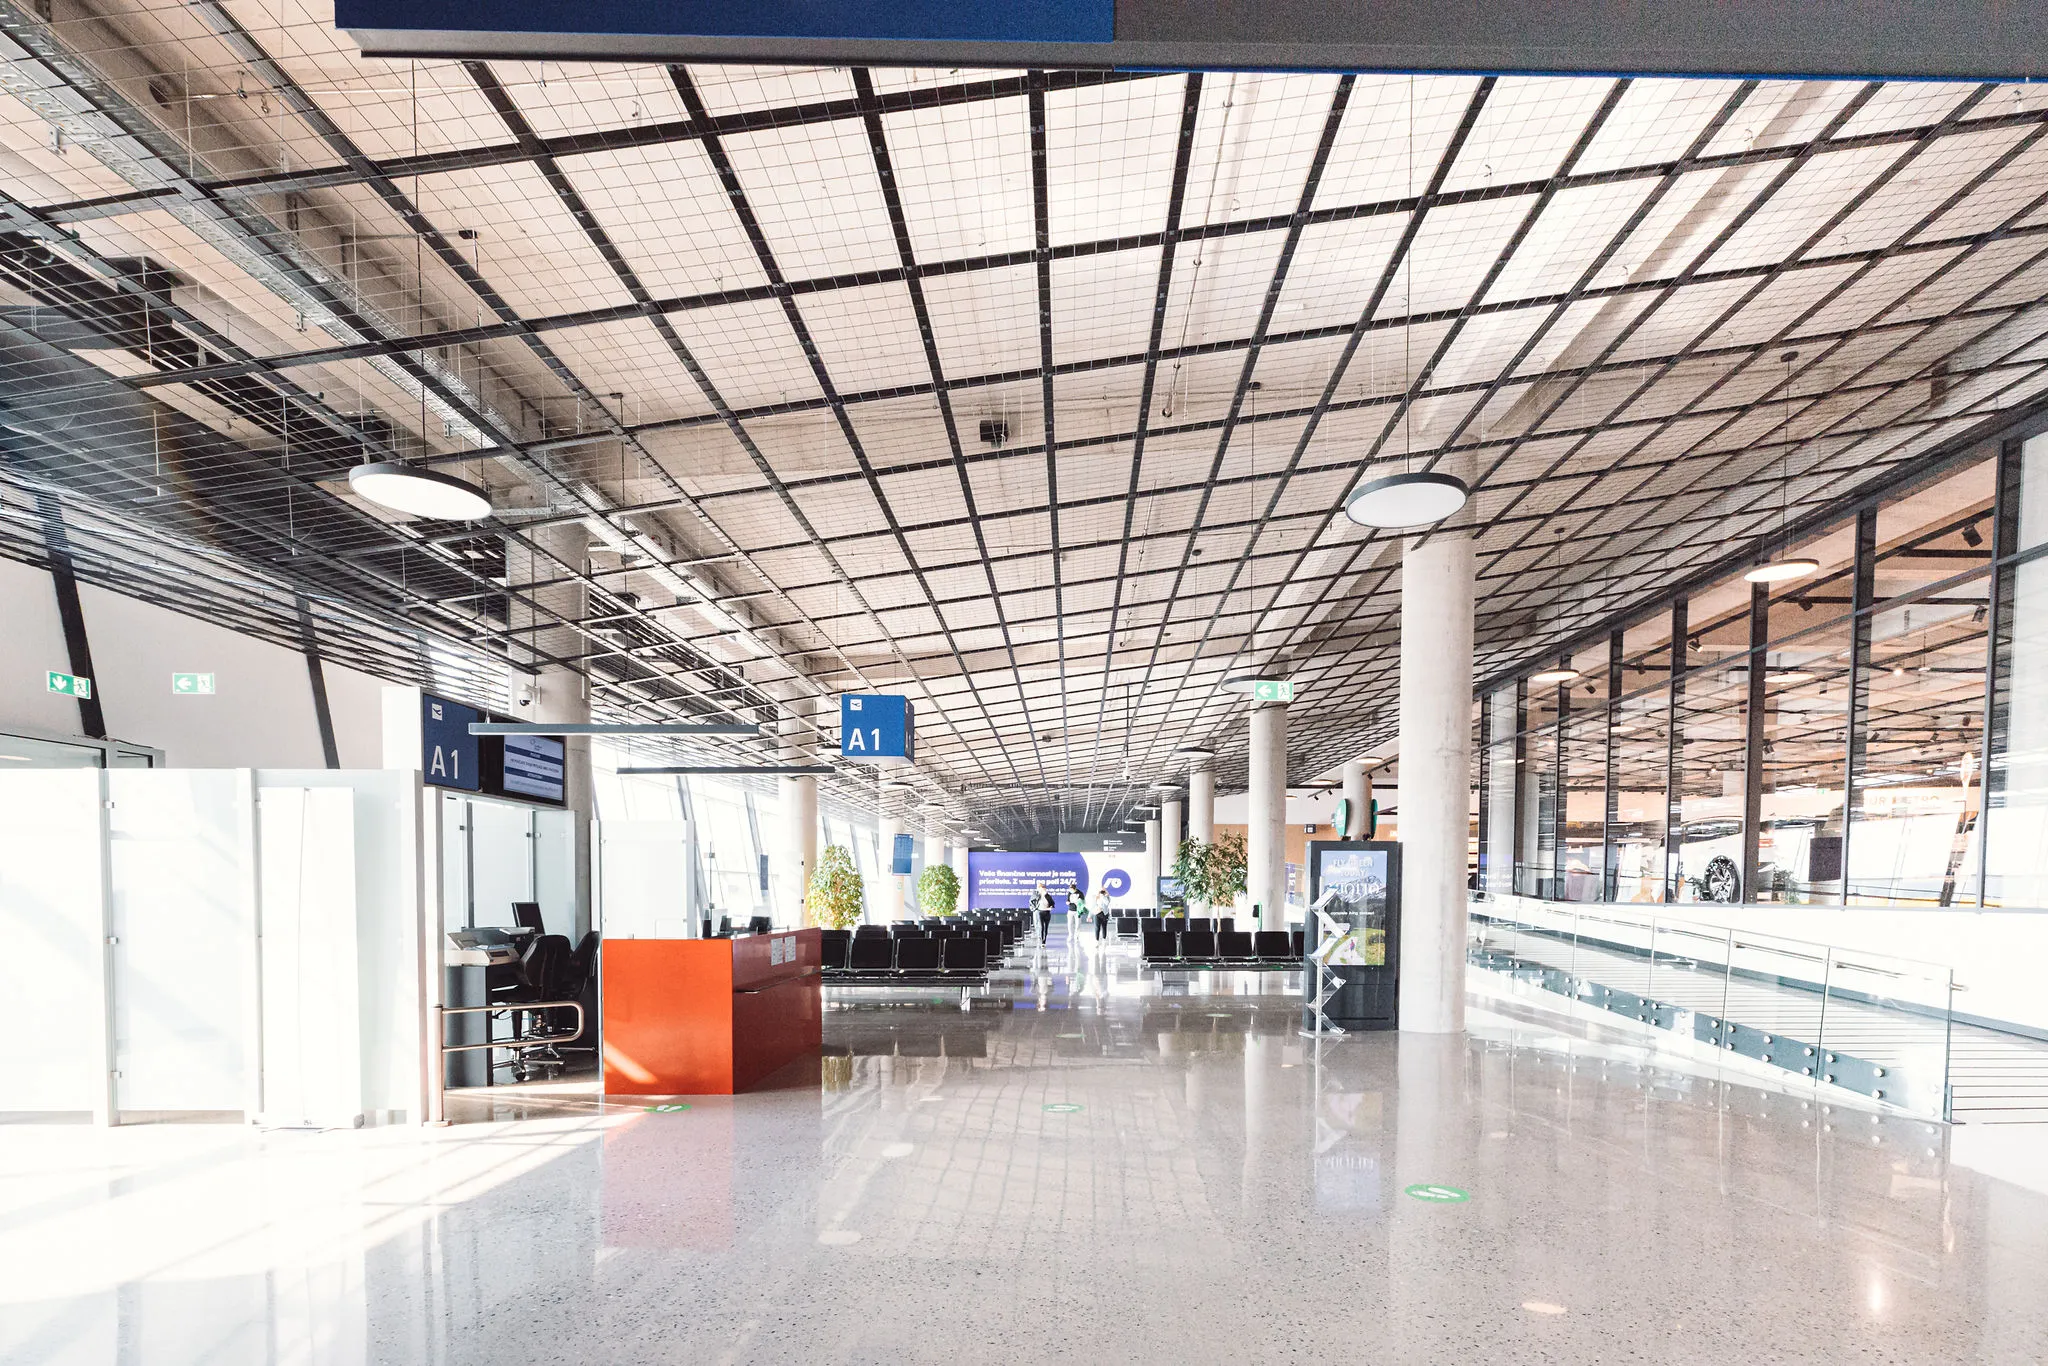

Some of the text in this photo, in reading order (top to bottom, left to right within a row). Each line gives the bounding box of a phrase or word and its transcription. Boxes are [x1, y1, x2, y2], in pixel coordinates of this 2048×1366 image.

[848, 728, 880, 751] A1
[430, 745, 459, 780] A1
[1052, 870, 1059, 878] je
[1046, 878, 1059, 886] poti
